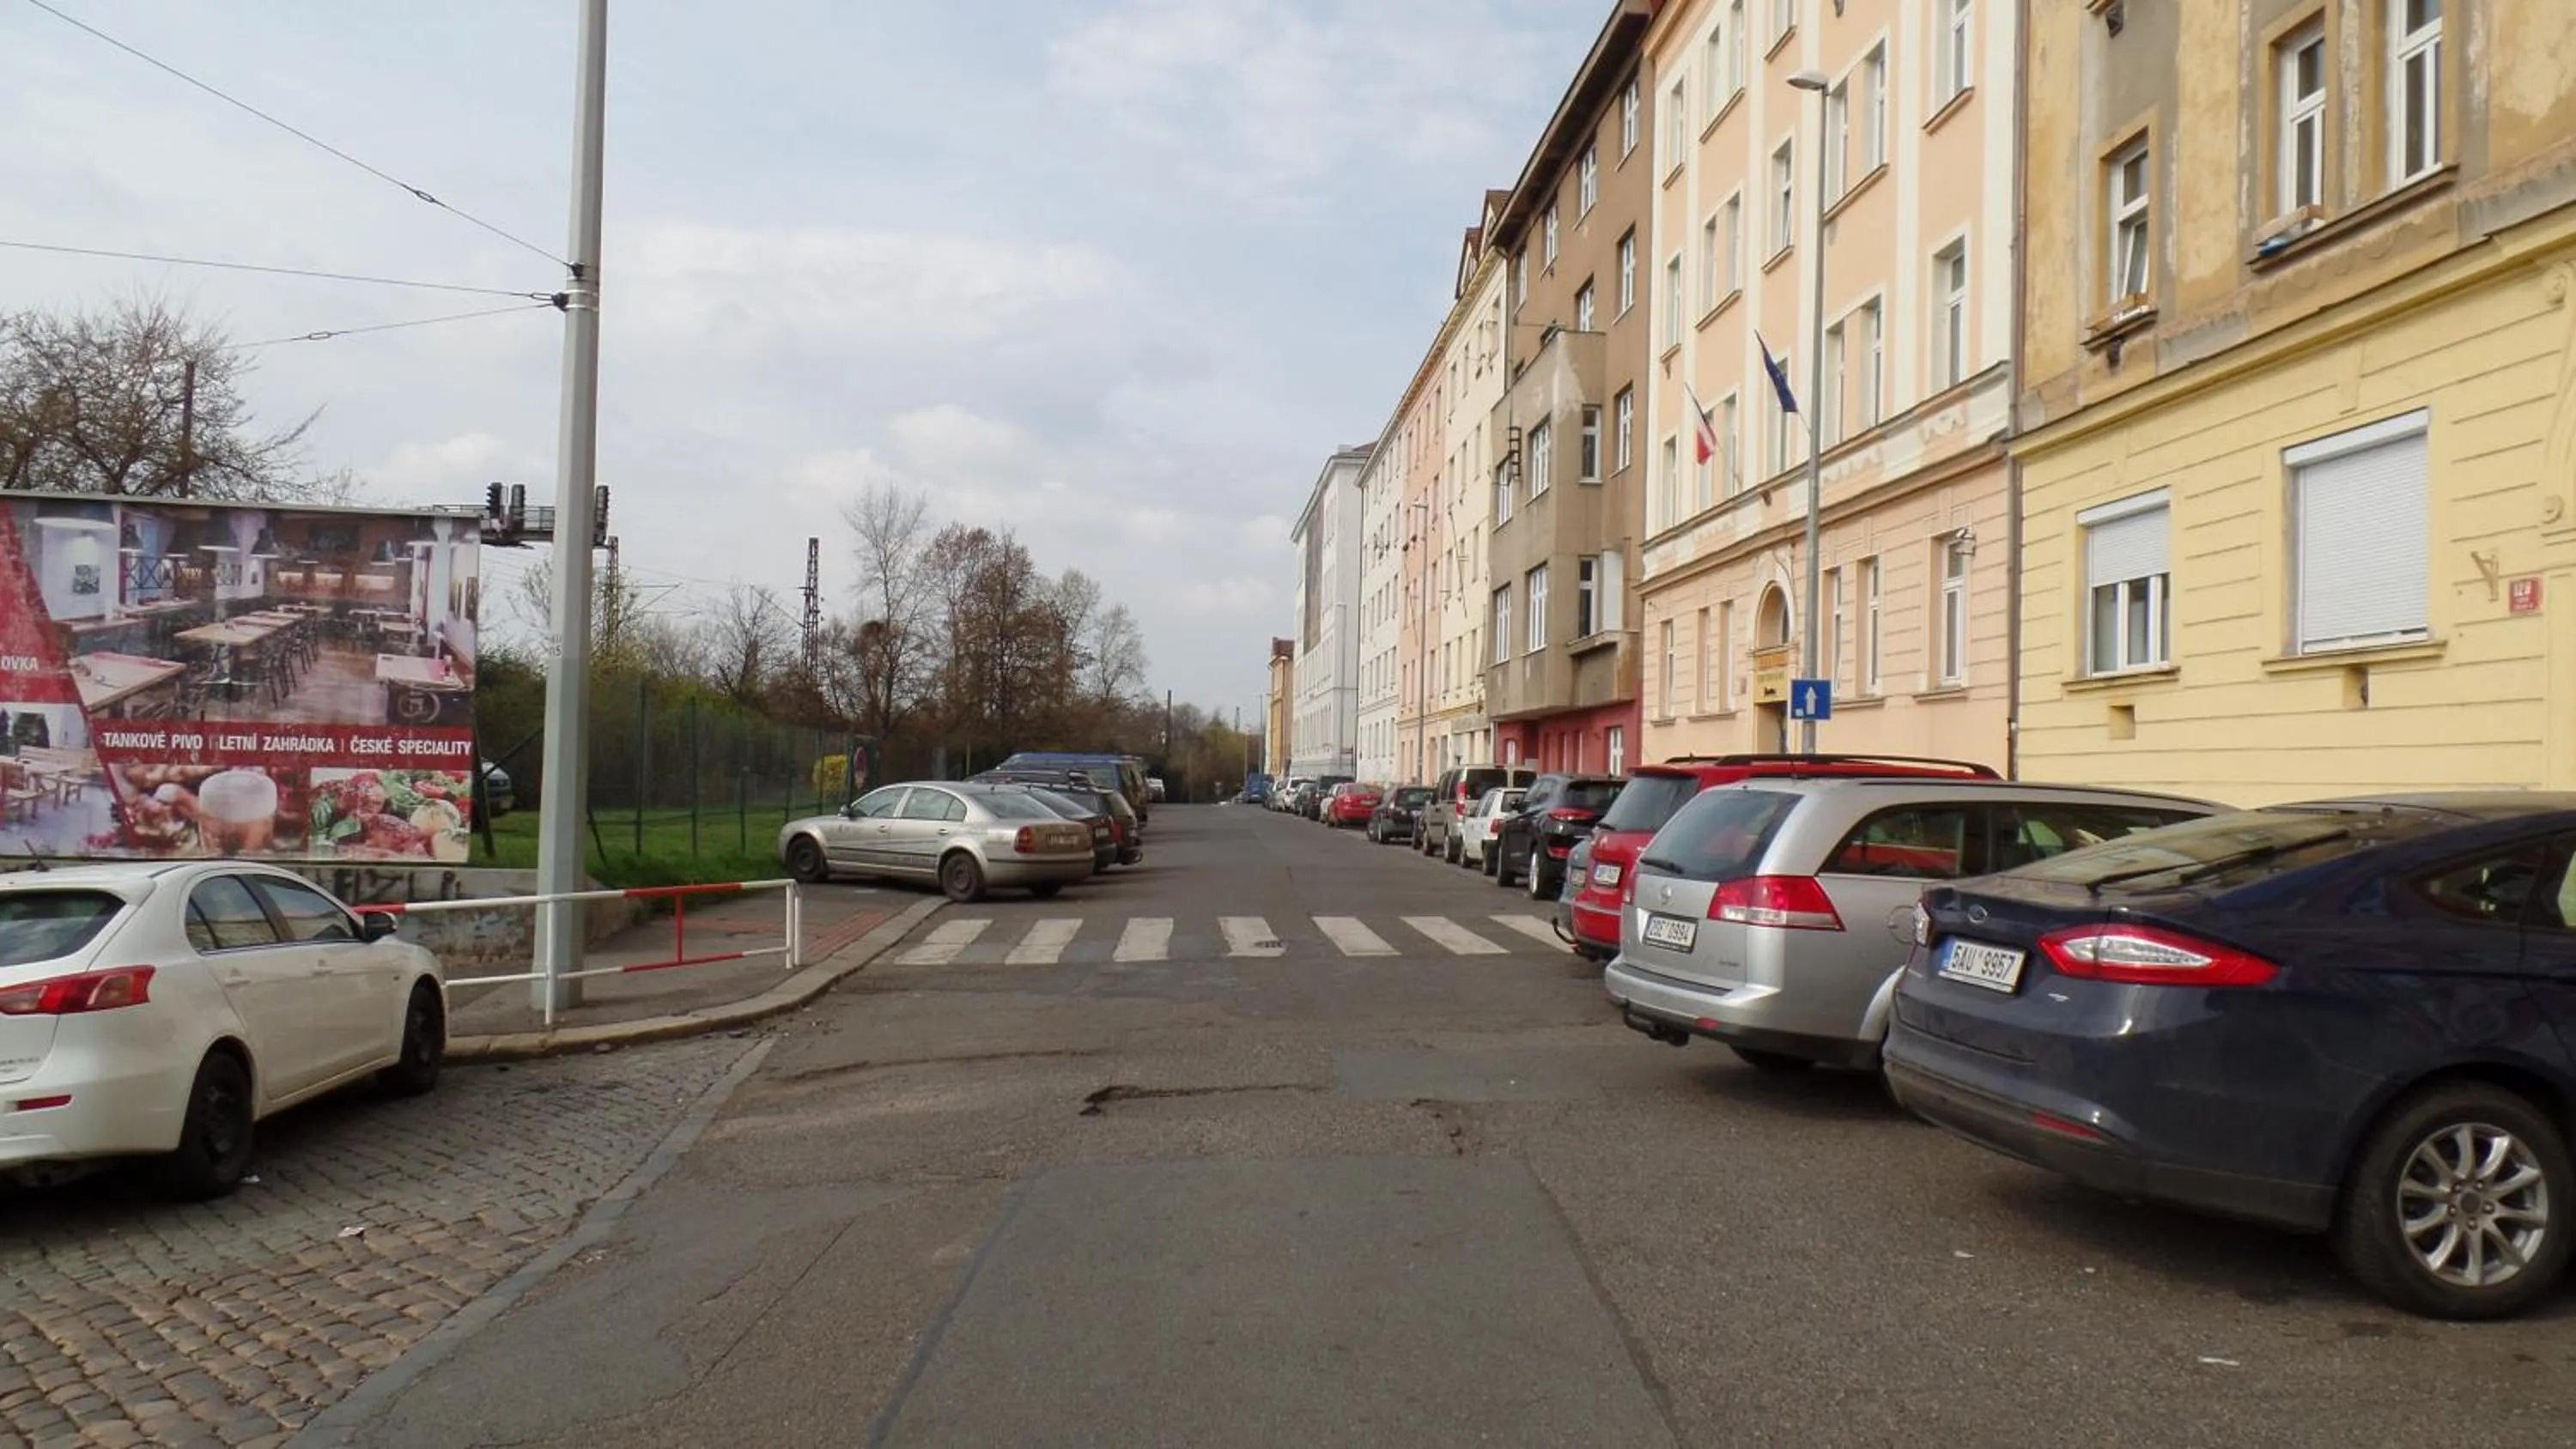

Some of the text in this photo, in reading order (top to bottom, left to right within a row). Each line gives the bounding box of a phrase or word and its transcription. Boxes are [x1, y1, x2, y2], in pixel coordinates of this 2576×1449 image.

[102, 731, 471, 755] TANKOVÉ PIVO LETNÍ ZAHRÁDKA ČESKÉ SPECIALITY
[1952, 944, 2016, 979] 5AU 9957
